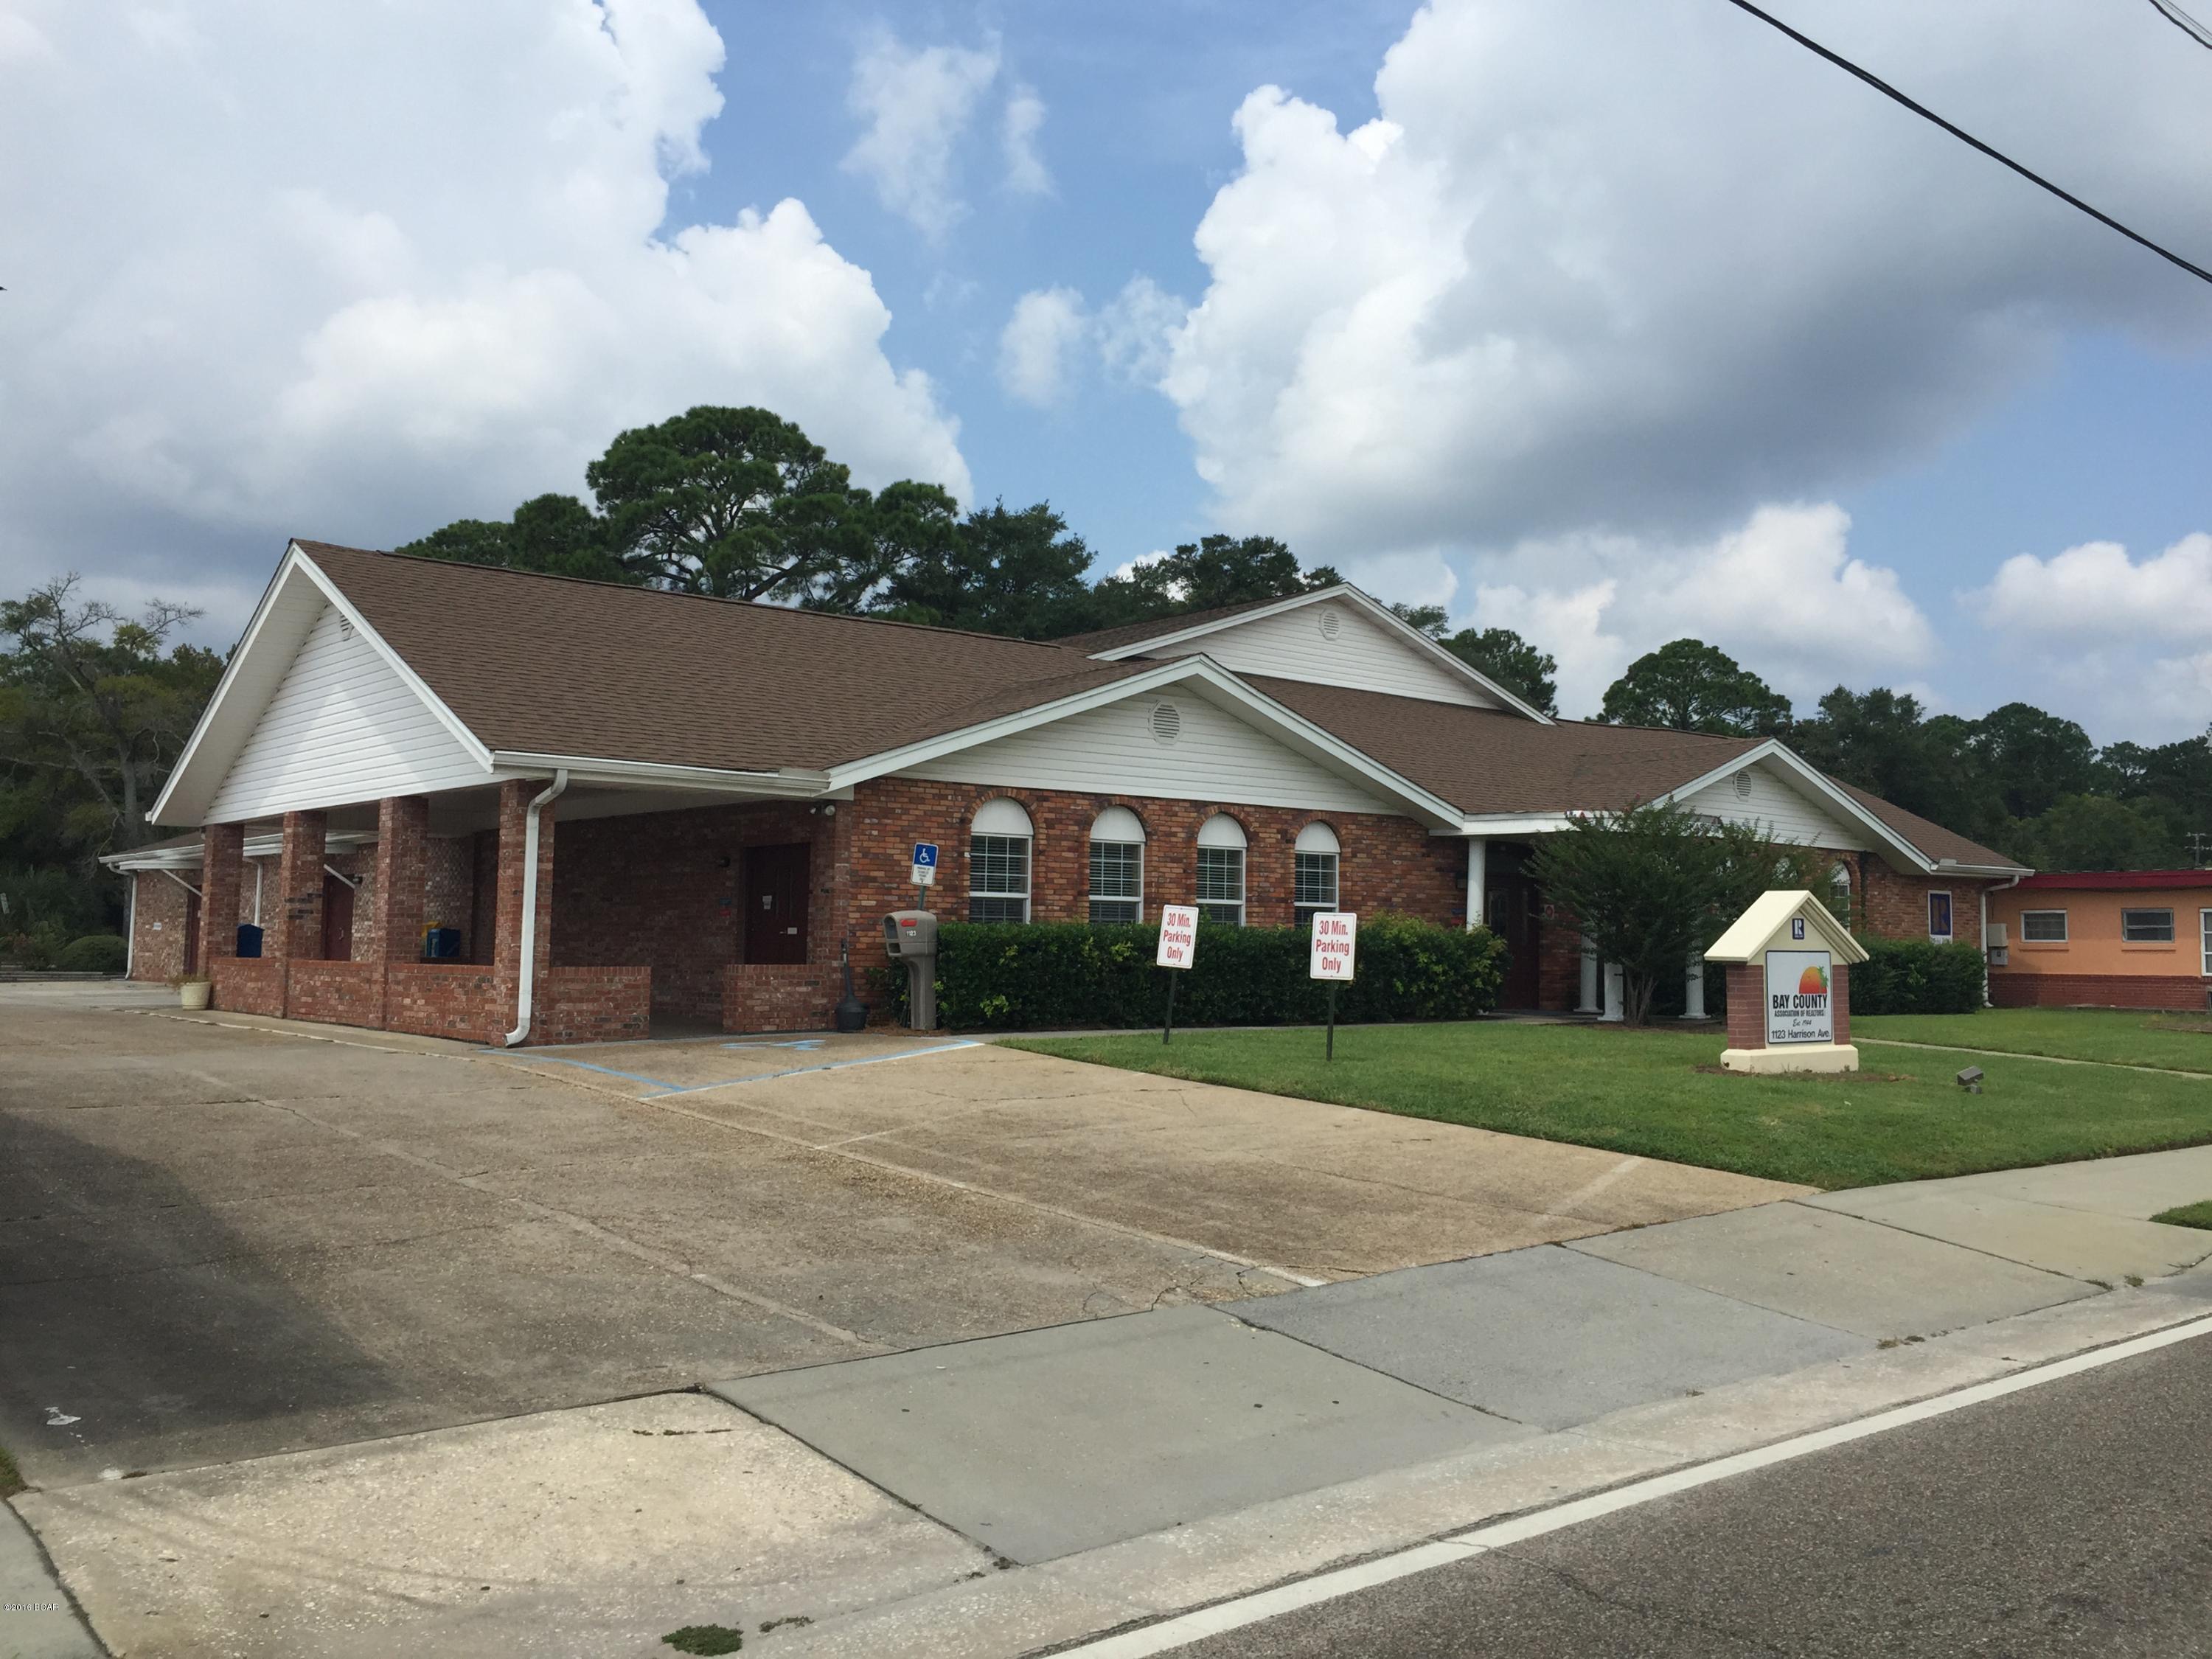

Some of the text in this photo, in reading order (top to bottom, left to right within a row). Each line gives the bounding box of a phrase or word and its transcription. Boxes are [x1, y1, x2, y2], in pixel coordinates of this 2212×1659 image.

[1167, 913, 1191, 928] 30 Min.
[1319, 920, 1348, 935] 30 Min.
[1163, 930, 1192, 947] Parking
[1166, 946, 1183, 962] Only
[1315, 939, 1350, 956] Parking
[1321, 956, 1342, 974] Only
[1773, 994, 1828, 1009] BAY COUNTY
[1771, 1028, 1831, 1039] 1123 Harrison Ave.
